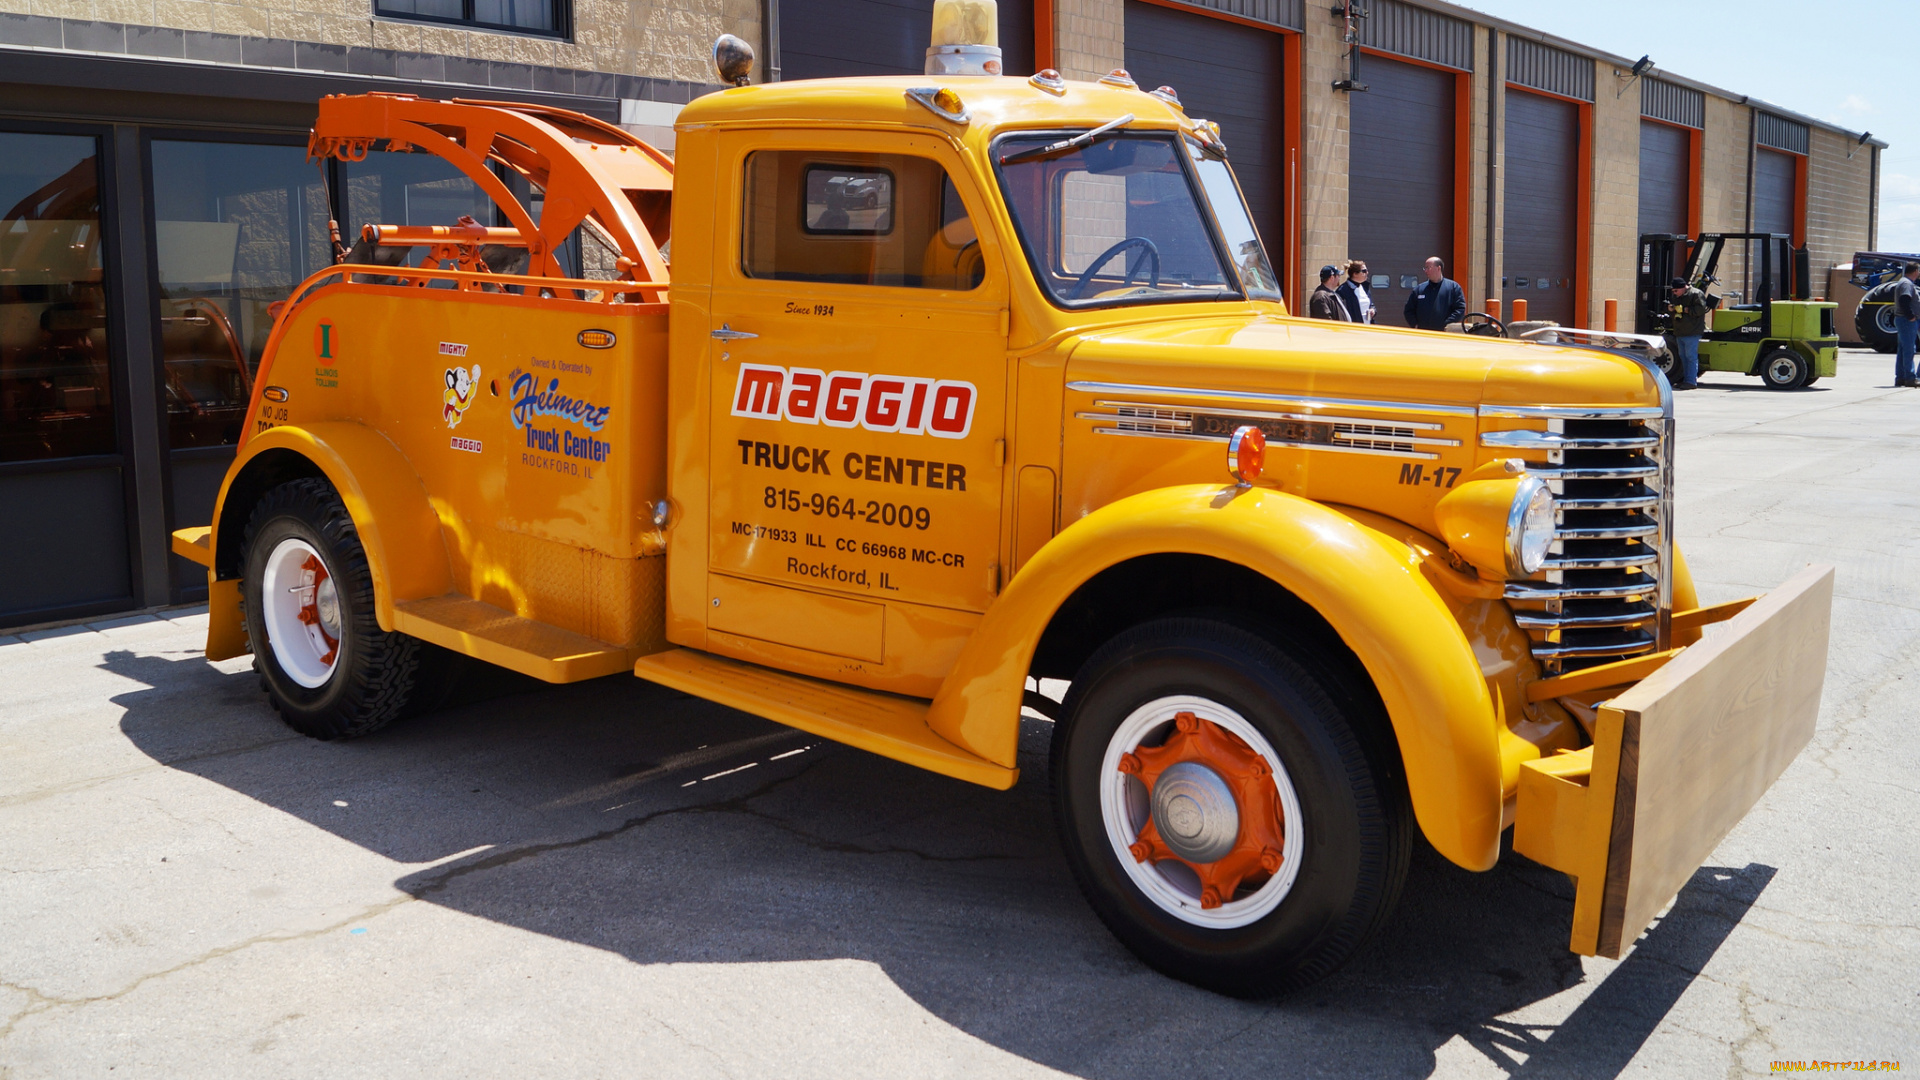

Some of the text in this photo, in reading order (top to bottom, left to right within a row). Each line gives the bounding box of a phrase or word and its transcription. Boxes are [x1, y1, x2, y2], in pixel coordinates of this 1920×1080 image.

[785, 302, 835, 317] Since 1934
[315, 367, 339, 378] ILLINOIS
[531, 356, 592, 377] Owned & Operated by
[262, 405, 288, 421] NO JOB
[510, 373, 611, 431] Heimert
[525, 422, 611, 463] Truck Center
[522, 452, 594, 480] ROCKFORD, IL
[738, 439, 967, 492] TRUCK CENTER
[1398, 462, 1463, 489] M-17
[763, 485, 931, 531] 815-964-2009
[731, 521, 965, 568] MC-171933 ILL CC 66968 MC-CR
[787, 556, 900, 591] Rockford, IL.
